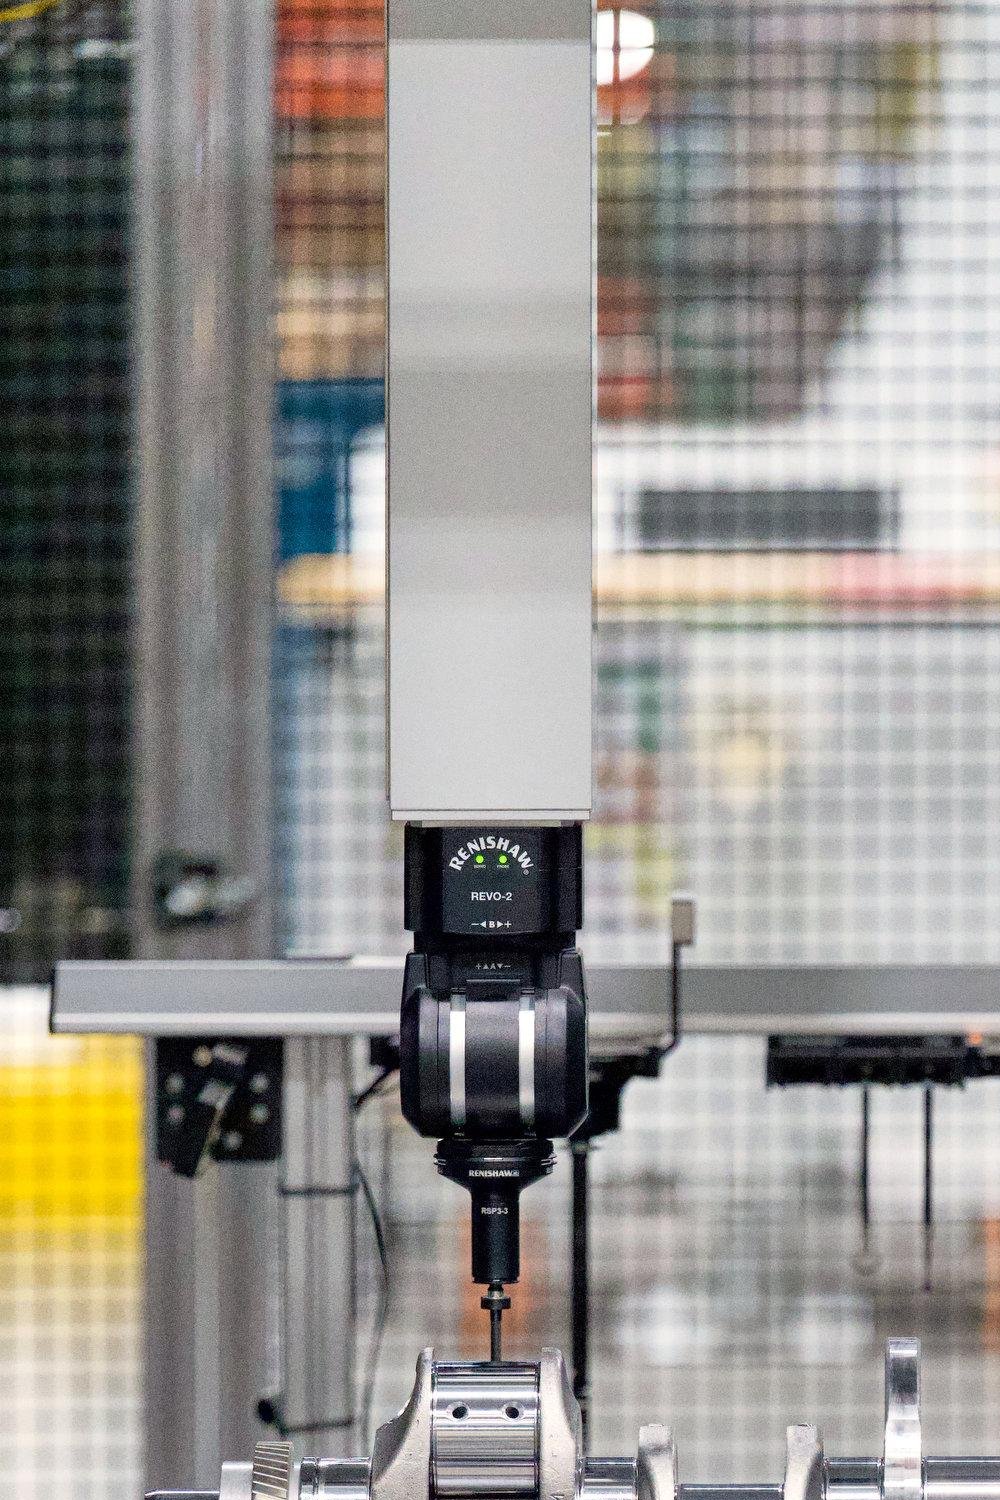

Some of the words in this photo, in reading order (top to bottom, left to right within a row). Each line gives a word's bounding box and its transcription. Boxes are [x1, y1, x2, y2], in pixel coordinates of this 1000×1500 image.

[449, 836, 534, 871] RENISHAW
[471, 892, 513, 901] REVO-2
[468, 1169, 512, 1177] RENISHAW
[481, 1207, 509, 1215] RSP3-3
